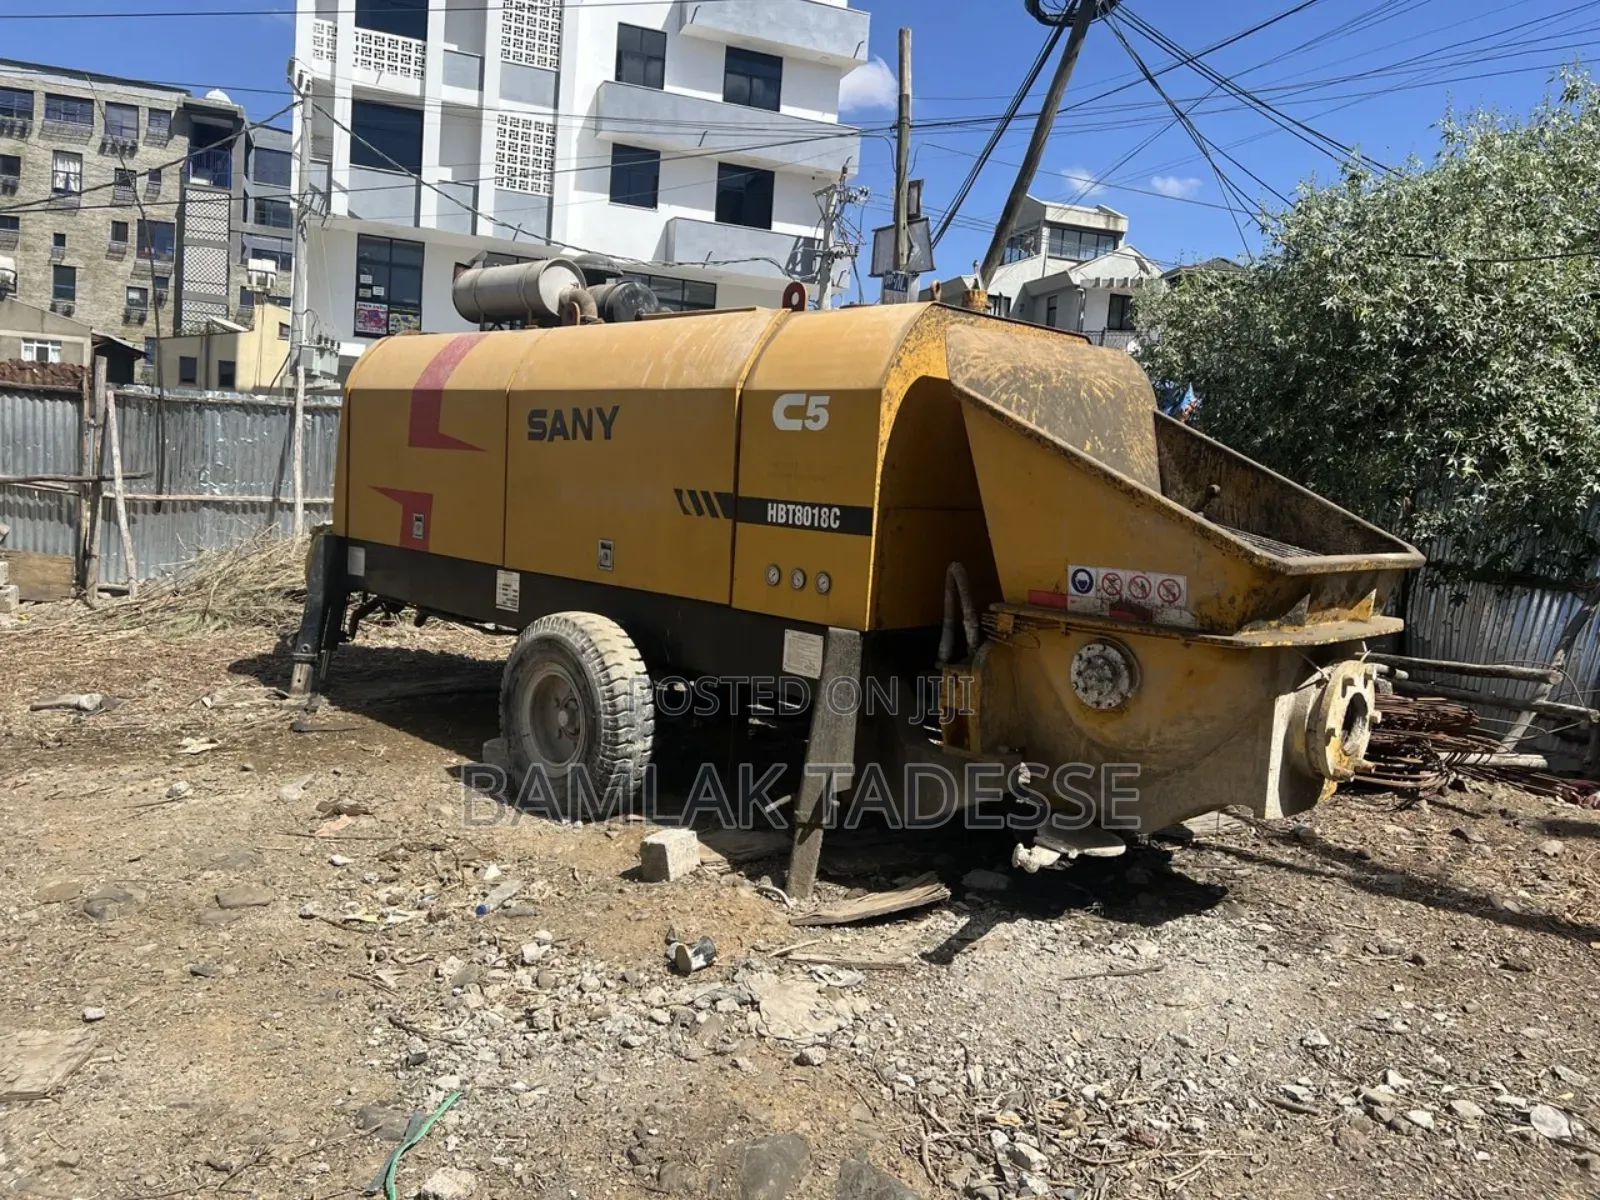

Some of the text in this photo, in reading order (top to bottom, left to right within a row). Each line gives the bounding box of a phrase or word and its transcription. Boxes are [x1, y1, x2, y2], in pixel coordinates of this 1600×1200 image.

[527, 405, 620, 442] SANY
[772, 393, 830, 431] C5
[767, 502, 840, 529] HBT8018C
